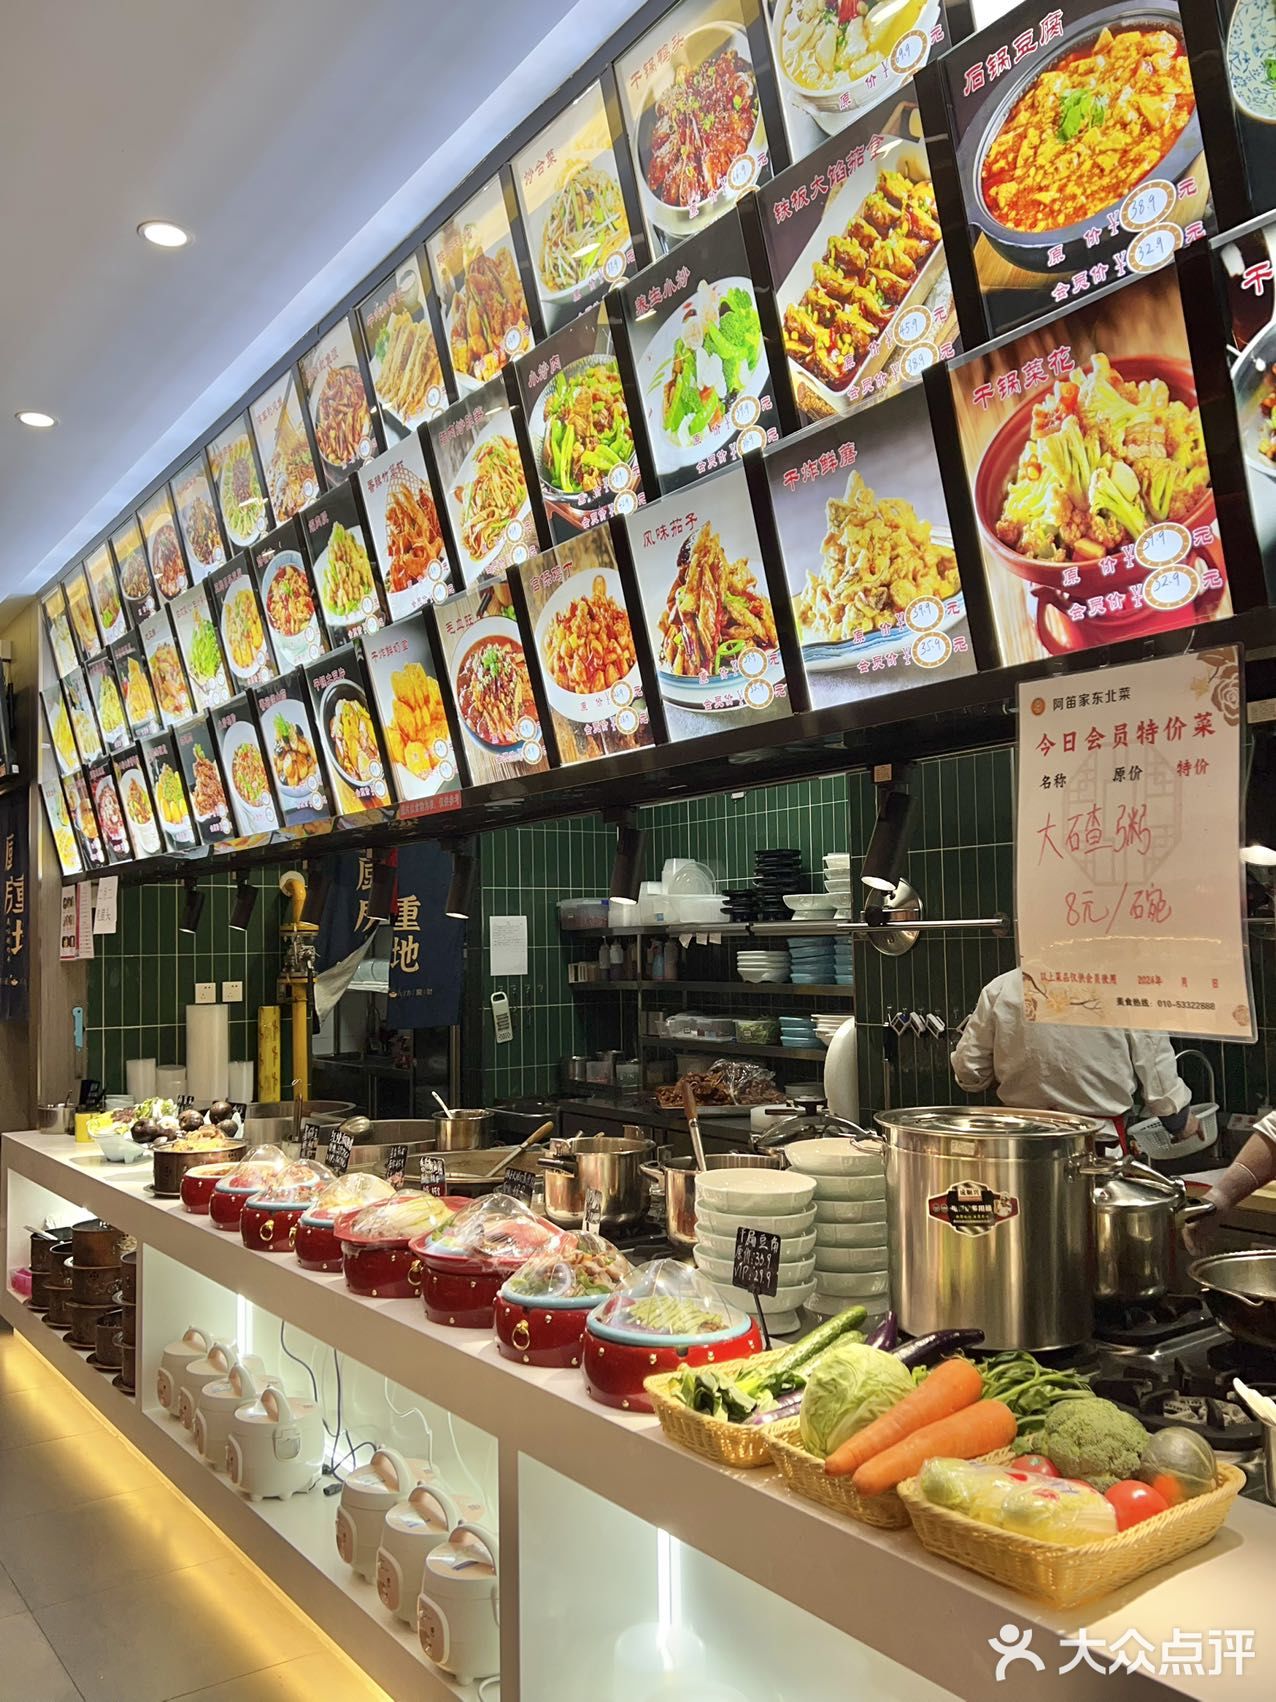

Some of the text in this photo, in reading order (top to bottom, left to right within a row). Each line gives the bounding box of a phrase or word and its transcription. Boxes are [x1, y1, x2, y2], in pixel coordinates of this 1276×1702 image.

[963, 9, 1065, 97] 石锅豆腐
[973, 345, 1076, 410] 干锅菜花
[783, 441, 858, 493] 干炸鲜蘑
[643, 512, 698, 548] 风味茄子
[1053, 687, 1131, 711] 阿笛家东北菜
[1035, 711, 1216, 757] 今日会员特价菜
[1039, 758, 1209, 790] 名称 原价 特价
[1037, 803, 1151, 866] 大碴粥
[389, 894, 421, 973] 重地
[1065, 882, 1172, 935] 8元/碗
